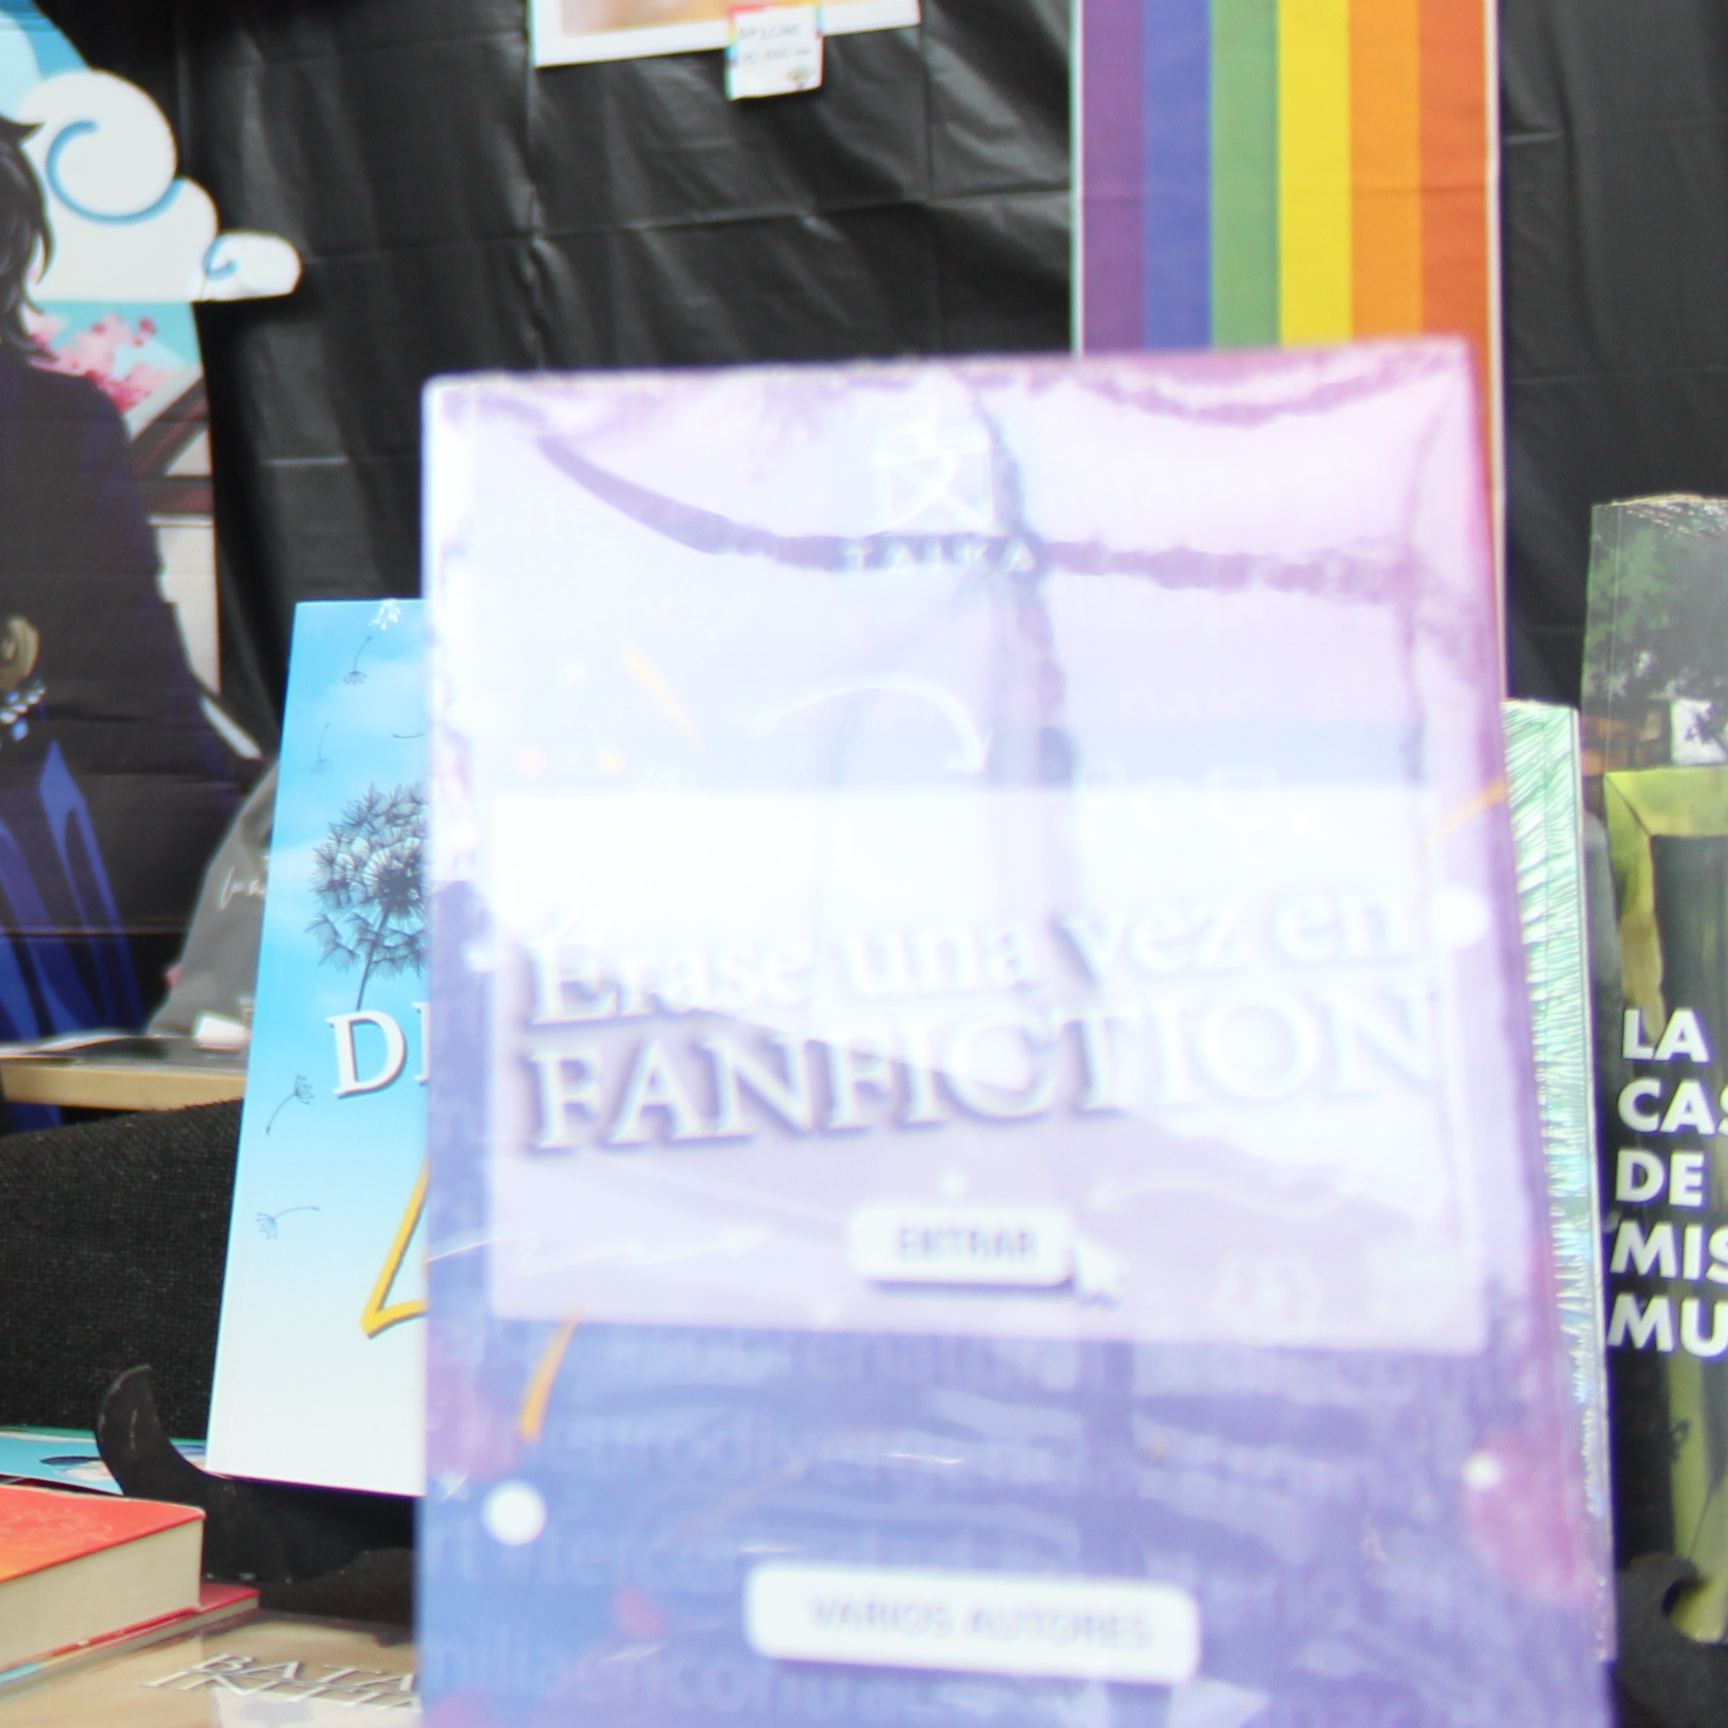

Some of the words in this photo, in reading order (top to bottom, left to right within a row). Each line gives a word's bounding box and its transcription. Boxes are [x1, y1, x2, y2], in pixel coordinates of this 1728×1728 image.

[1049, 897, 1255, 991] vez
[1273, 884, 1414, 970] en
[1621, 1007, 1710, 1064] LA
[523, 985, 1440, 1158] FANFICTION
[1614, 1150, 1704, 1206] DE
[892, 1224, 1040, 1264] ENTRAR
[1605, 1292, 1728, 1359] MU
